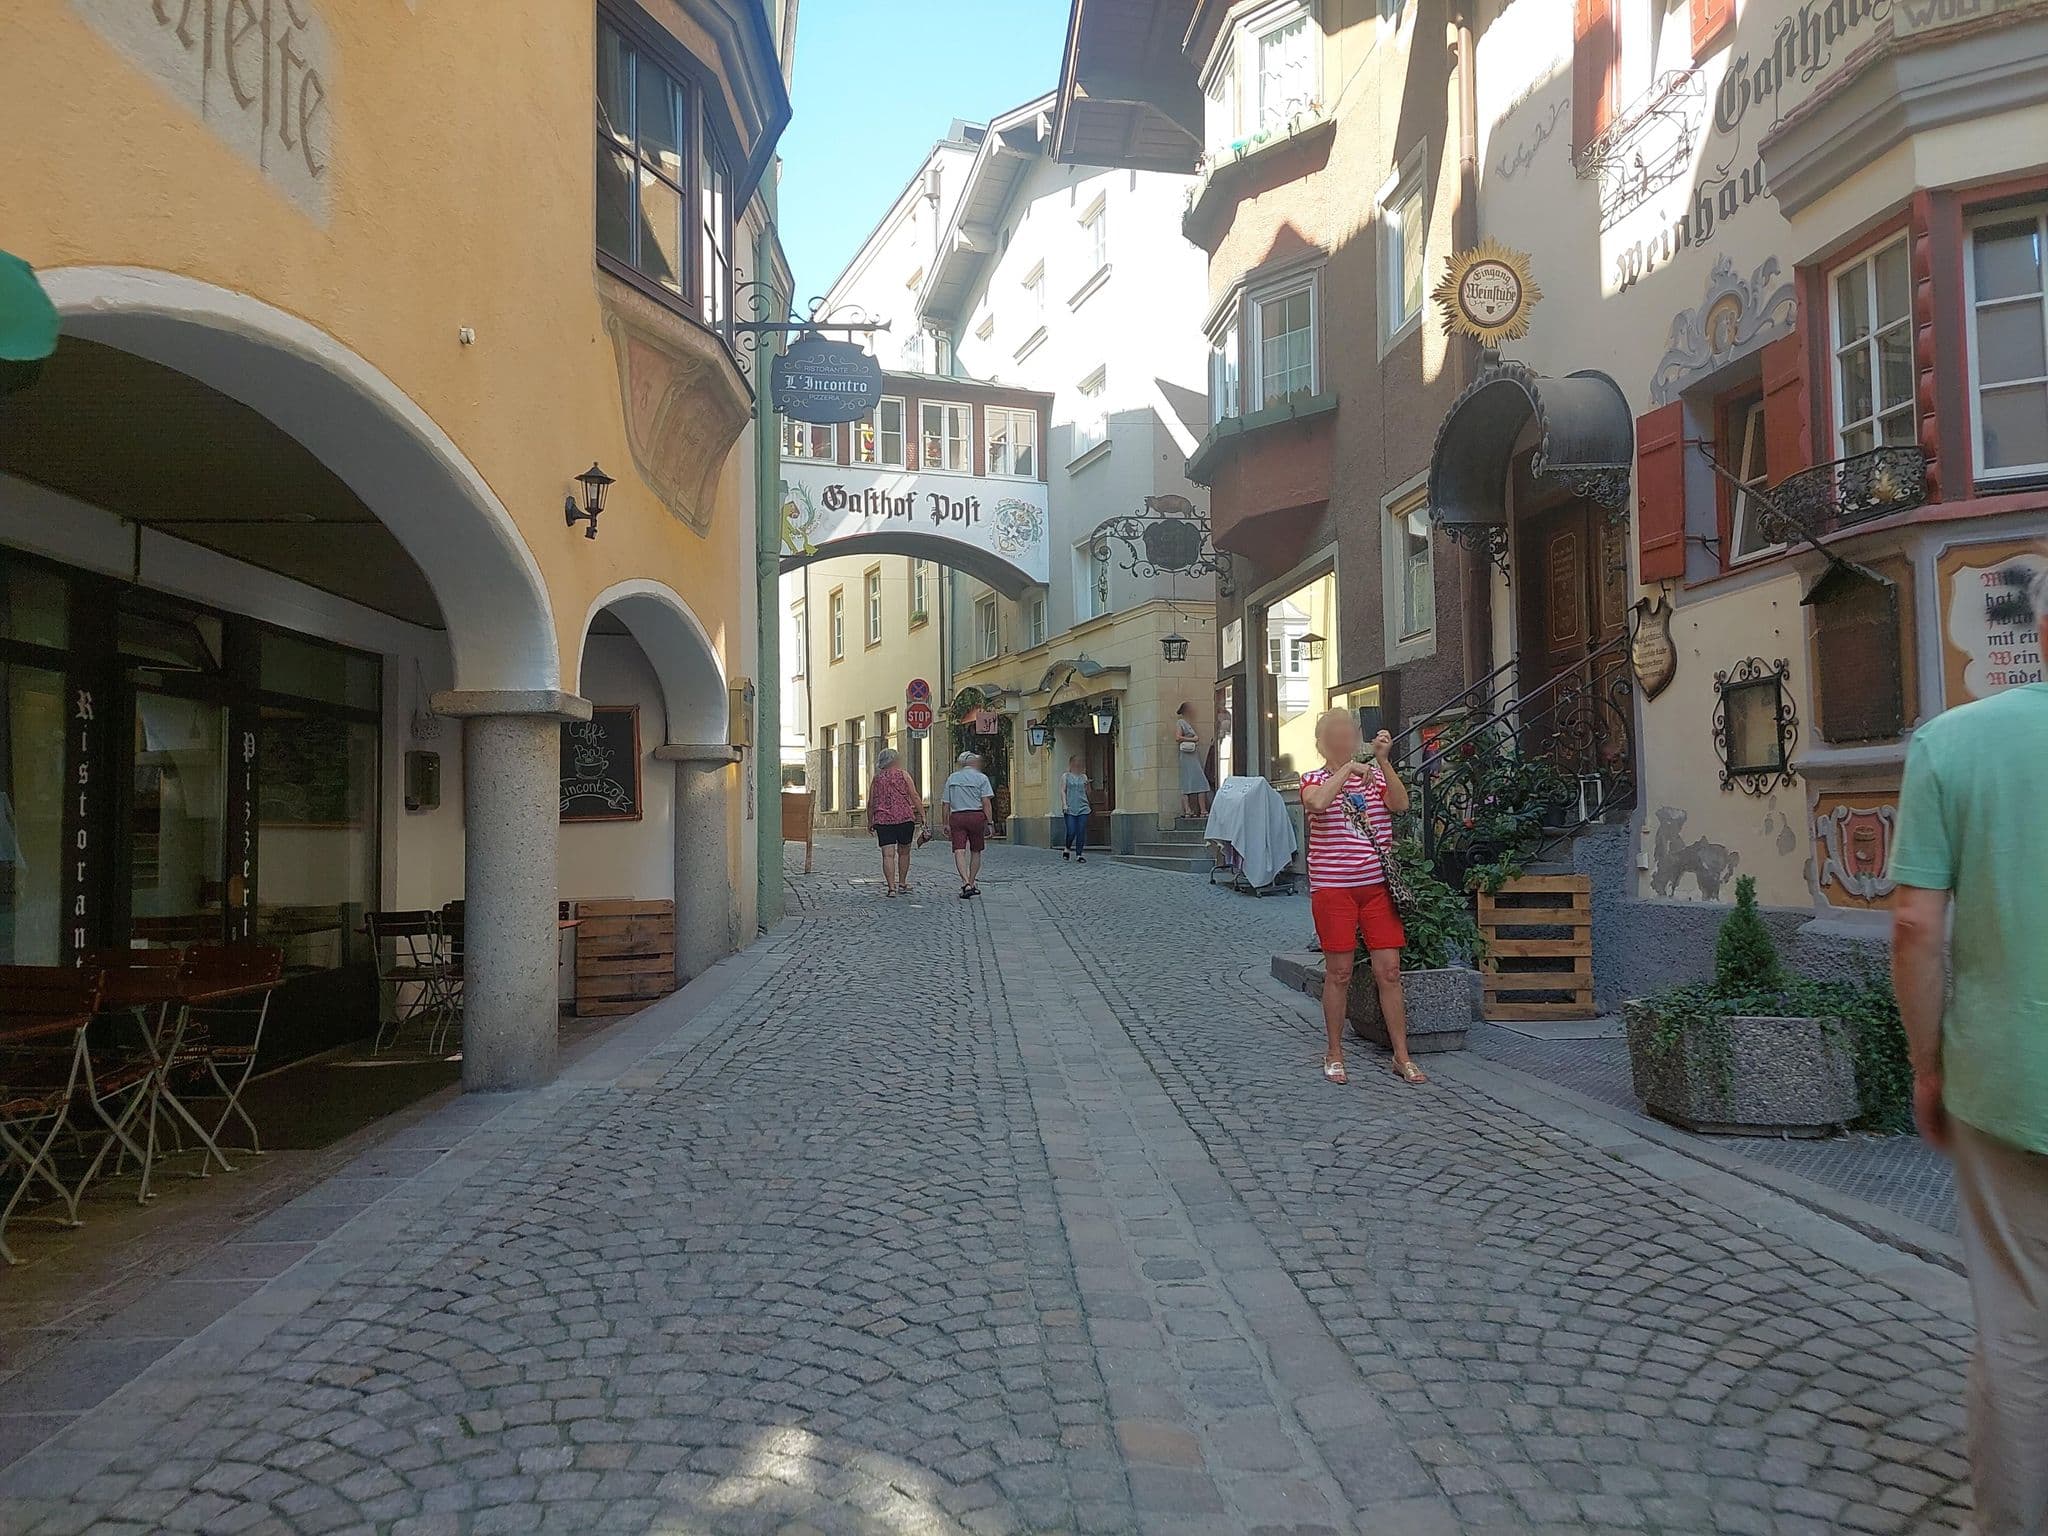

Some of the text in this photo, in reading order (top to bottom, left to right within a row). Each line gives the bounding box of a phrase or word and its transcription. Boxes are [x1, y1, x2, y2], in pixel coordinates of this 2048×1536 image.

[1613, 158, 1779, 294] Weinhau
[1473, 268, 1512, 285] Eingang
[804, 366, 849, 374] RISTORANTE
[784, 375, 868, 393] L'Incontro
[821, 484, 982, 528] Gasthof Post
[1987, 631, 2015, 646] mit
[1988, 650, 2041, 666] Wein
[908, 711, 931, 722] STOP
[561, 780, 619, 797] incontro
